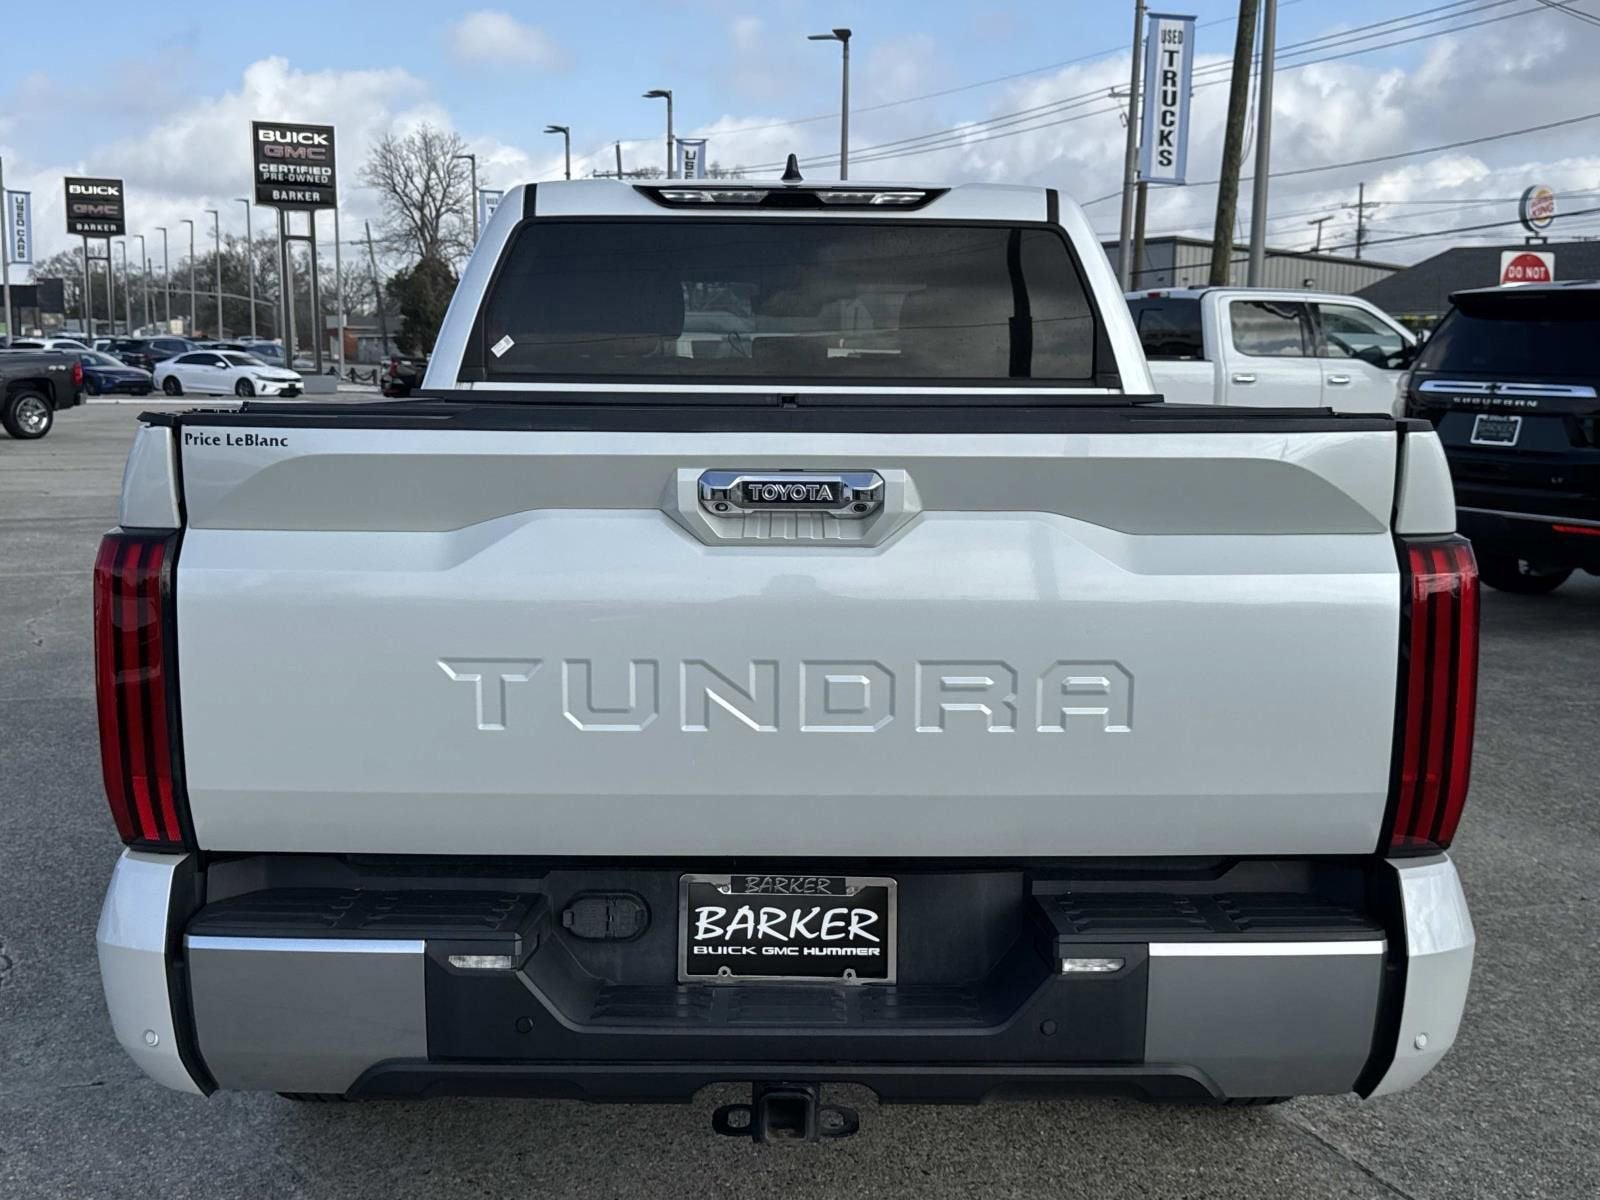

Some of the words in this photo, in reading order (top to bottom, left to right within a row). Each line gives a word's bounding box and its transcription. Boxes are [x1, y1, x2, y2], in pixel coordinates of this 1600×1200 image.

[1161, 29, 1184, 44] USED
[1158, 49, 1179, 167] TRUCKS
[258, 129, 330, 145] BUICK
[264, 144, 326, 160] GMC
[259, 163, 332, 176] CERTIFIED
[263, 172, 329, 184] PRE-OWNED
[69, 184, 120, 196] BUICK
[272, 190, 321, 202] BARKER
[73, 204, 119, 215] GMC
[76, 223, 117, 232] BARKER
[1508, 265, 1523, 279] DO
[1525, 266, 1546, 280] NOT
[184, 432, 221, 446] Price
[226, 433, 289, 447] LeBlanc
[749, 484, 833, 501] TOYOTA
[436, 656, 1136, 733] TUNDRA
[744, 875, 832, 895] BARKER
[693, 904, 881, 943] BARKER
[693, 945, 757, 956] BUICK
[762, 946, 800, 956] GMC
[803, 946, 881, 957] HUMMER
